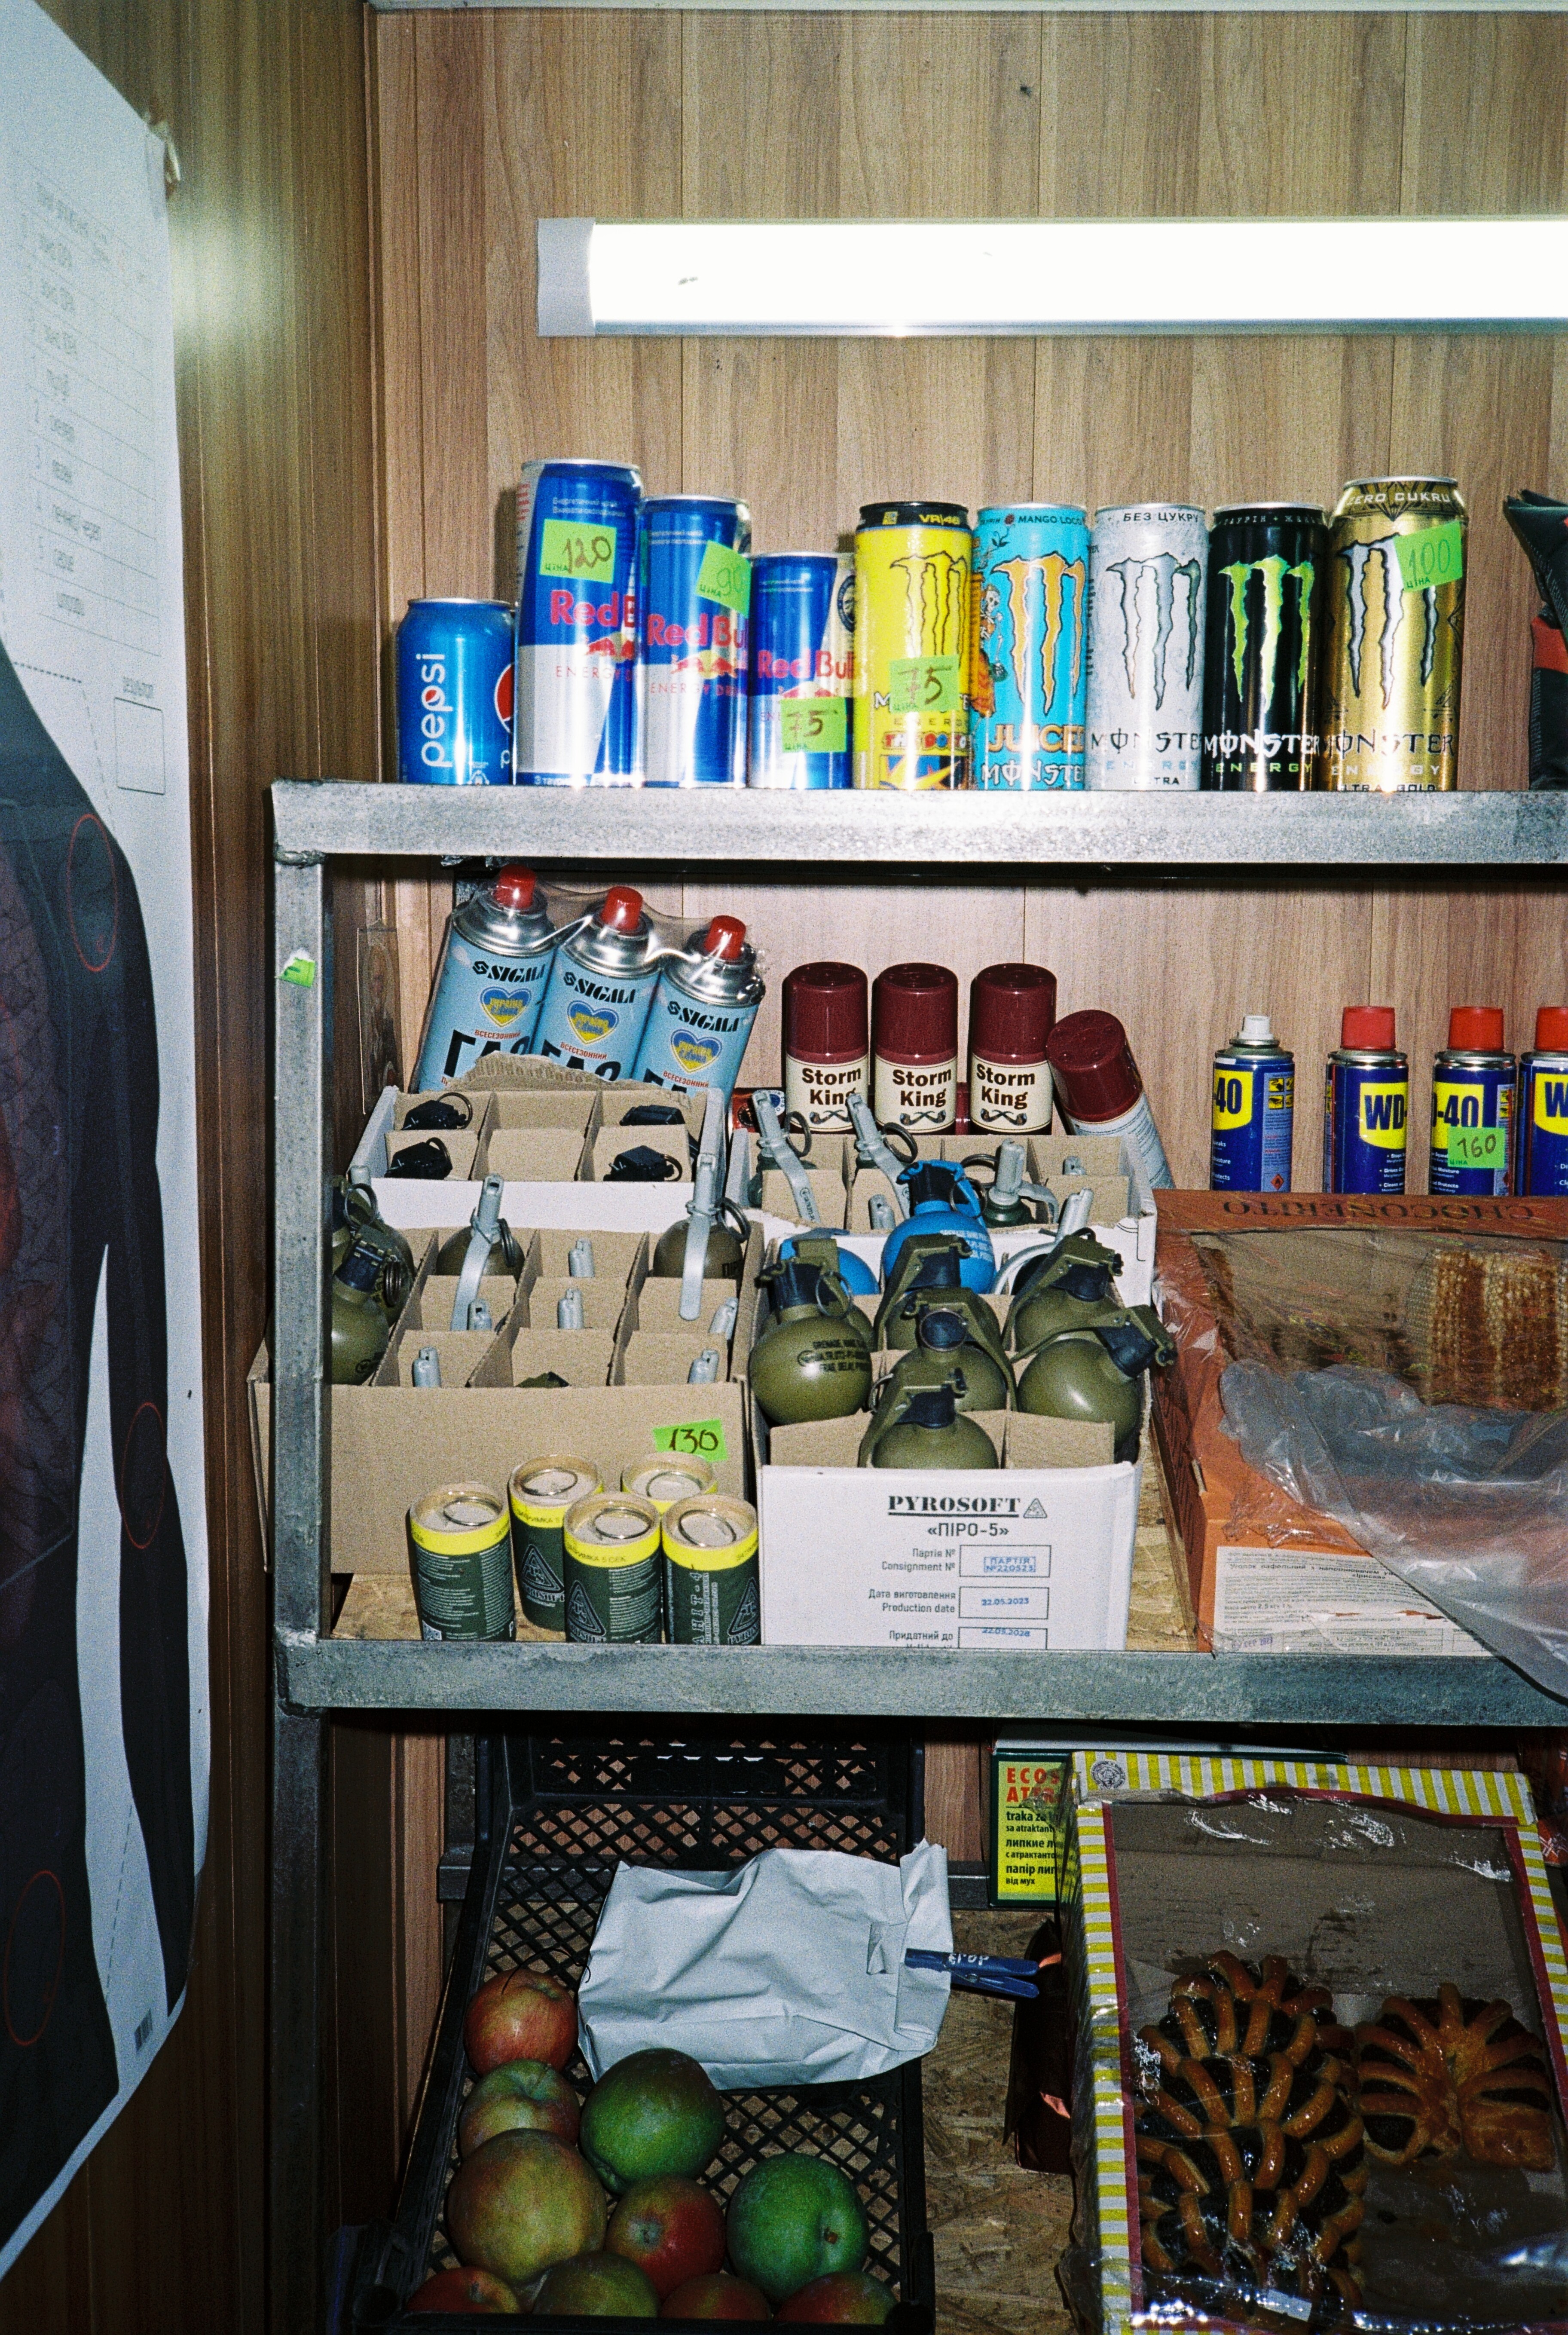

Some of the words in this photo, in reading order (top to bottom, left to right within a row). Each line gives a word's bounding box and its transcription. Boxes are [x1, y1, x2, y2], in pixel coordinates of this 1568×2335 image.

[1347, 493, 1385, 505] ZERO
[1396, 493, 1450, 502] CUKRU
[1018, 515, 1057, 524] MANGO
[1123, 513, 1151, 522] БЕЗ
[1158, 512, 1199, 523] ЦУКРУ
[562, 536, 611, 574] 120
[1409, 539, 1450, 584] 100
[551, 590, 618, 627] Red
[648, 614, 708, 646] Red
[758, 649, 811, 679] Red
[898, 666, 951, 705] 75
[416, 654, 453, 767] pepsi
[787, 710, 829, 741] 75
[885, 733, 920, 748] TH
[987, 724, 1085, 752] JUICE
[1215, 762, 1312, 773] ENERGY
[1331, 765, 1440, 775] ENGY
[488, 964, 545, 982] SIGMA
[575, 978, 636, 1004] SIGMA
[679, 1007, 740, 1032] SIGMA
[802, 1068, 861, 1085] Storm
[893, 1069, 952, 1086] Storm
[976, 1063, 1035, 1086] Storm
[900, 1088, 947, 1108] King
[981, 1085, 1028, 1110] King
[1545, 1081, 1568, 1118] W
[1457, 1134, 1497, 1158] 160
[669, 1428, 718, 1453] 130
[888, 1495, 1021, 1512] PYROSOFT
[927, 1523, 1009, 1537] «ПІРО-5»
[912, 1548, 943, 1559] Партія
[882, 1561, 942, 1573] Consignment
[868, 1589, 891, 1600] Дата
[893, 1590, 957, 1600] виготовлення
[981, 1597, 1030, 1607] 22.05.2023
[882, 1603, 932, 1613] Production
[935, 1604, 955, 1613] date
[889, 1630, 939, 1640] Придатний
[941, 1632, 954, 1641] до
[1006, 1810, 1033, 1821] traka
[1006, 1839, 1045, 1848] липкие
[1006, 1863, 1036, 1876] папір
[1006, 1876, 1019, 1885] від
[1020, 1878, 1036, 1887] мух
